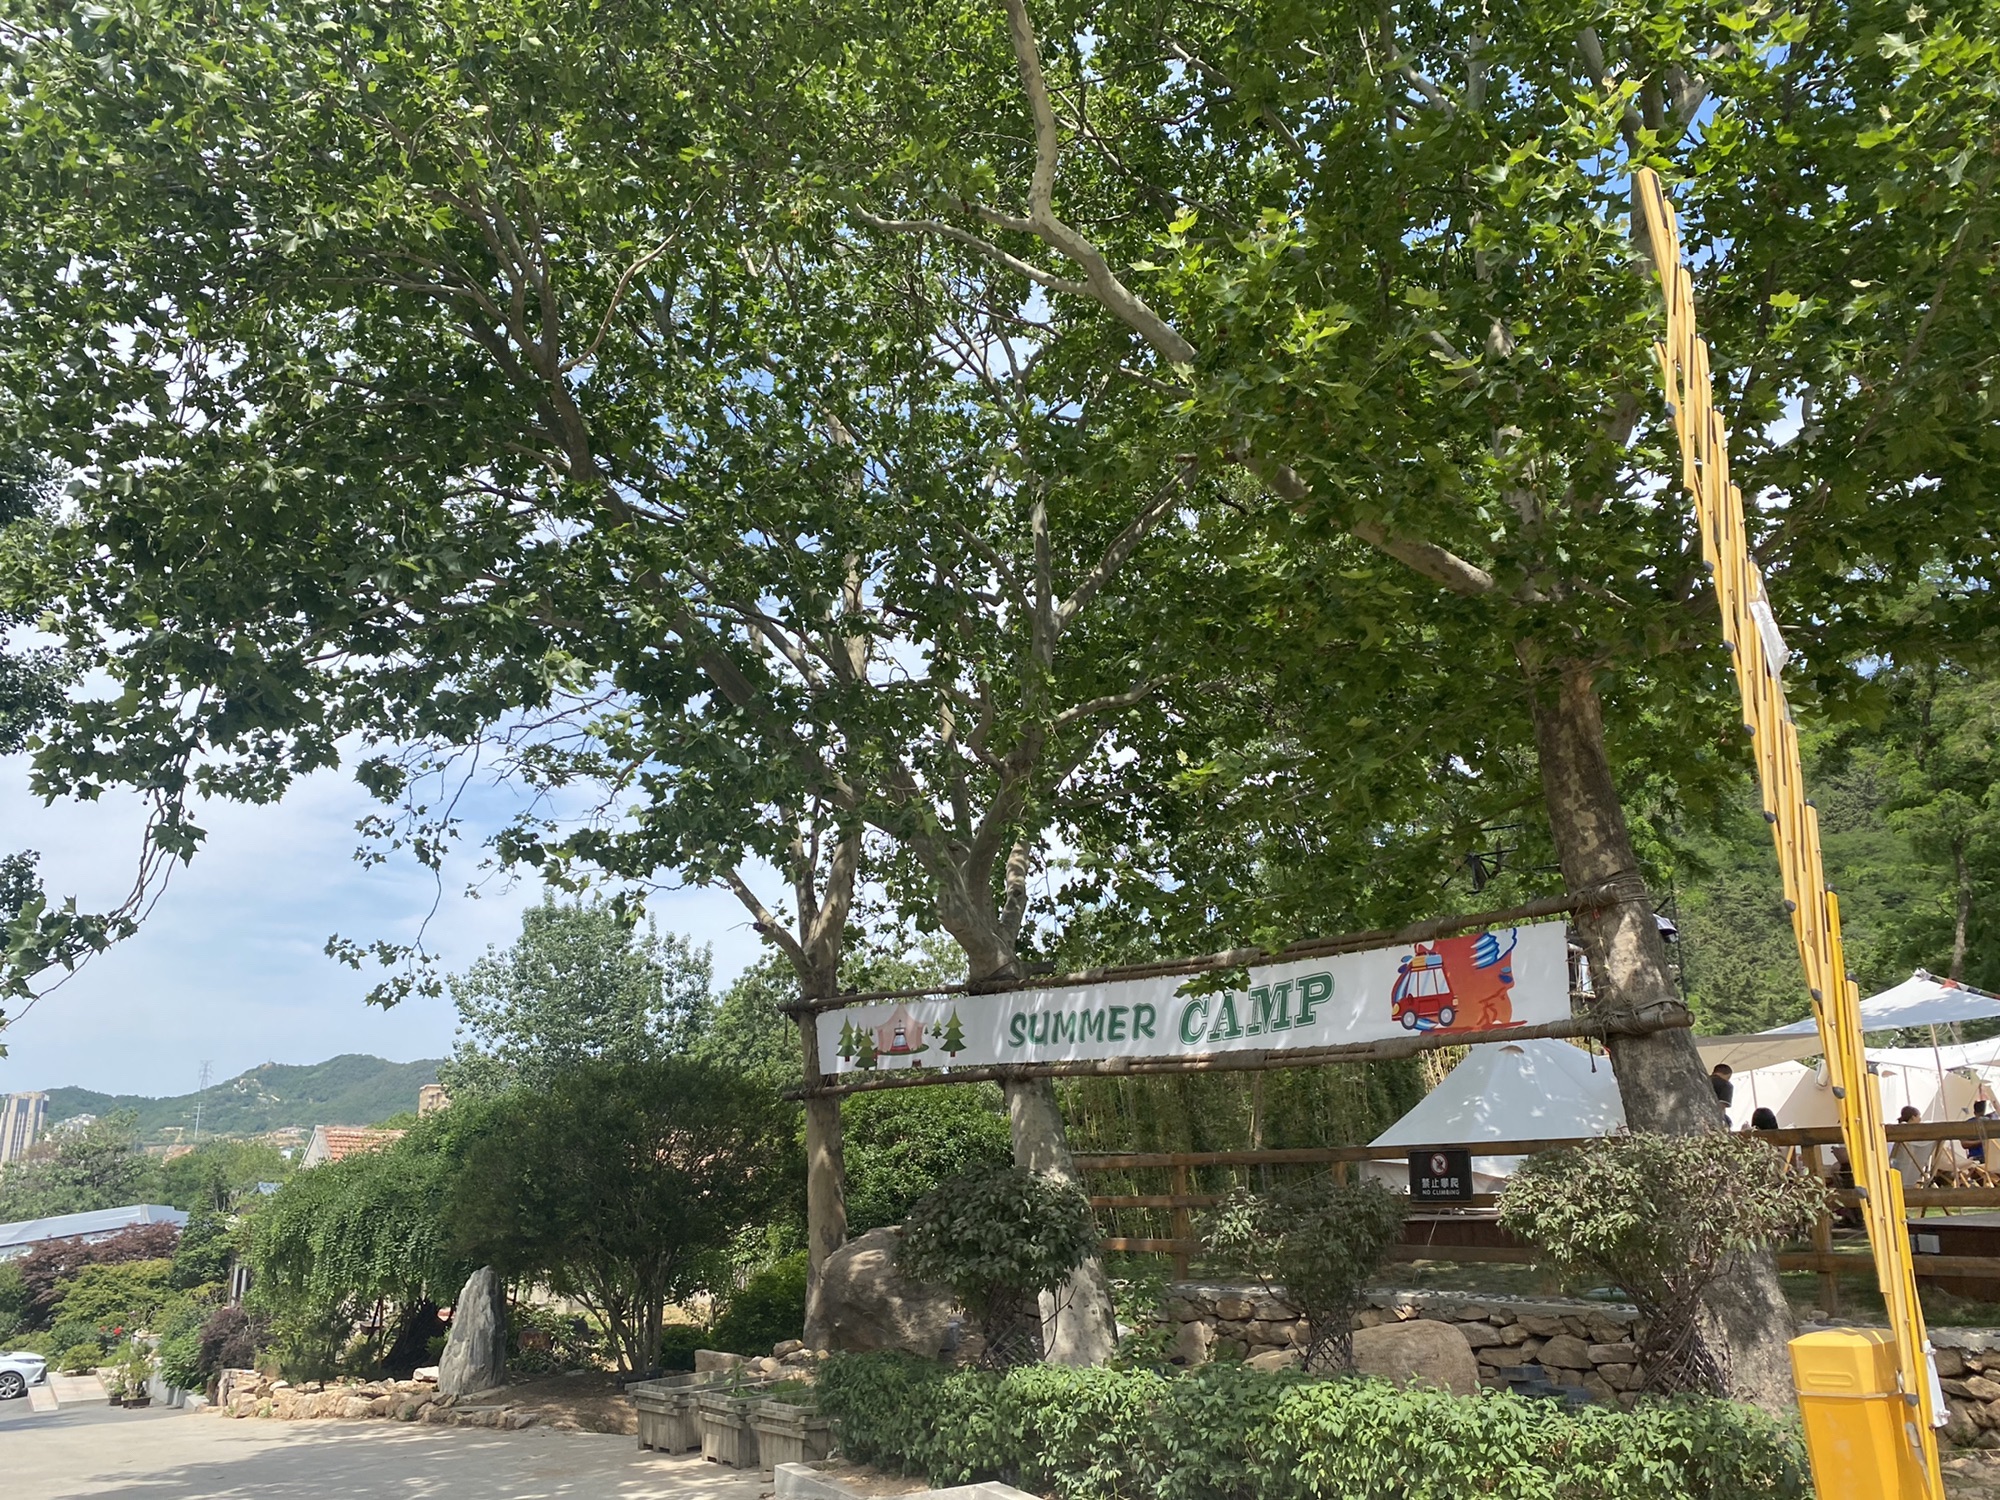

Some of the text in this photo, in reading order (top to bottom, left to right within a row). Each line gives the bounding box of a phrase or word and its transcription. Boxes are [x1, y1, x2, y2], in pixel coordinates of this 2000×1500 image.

[1008, 971, 1335, 1048] SUMMER CAMP
[1421, 1177, 1459, 1189] 禁止攀爬
